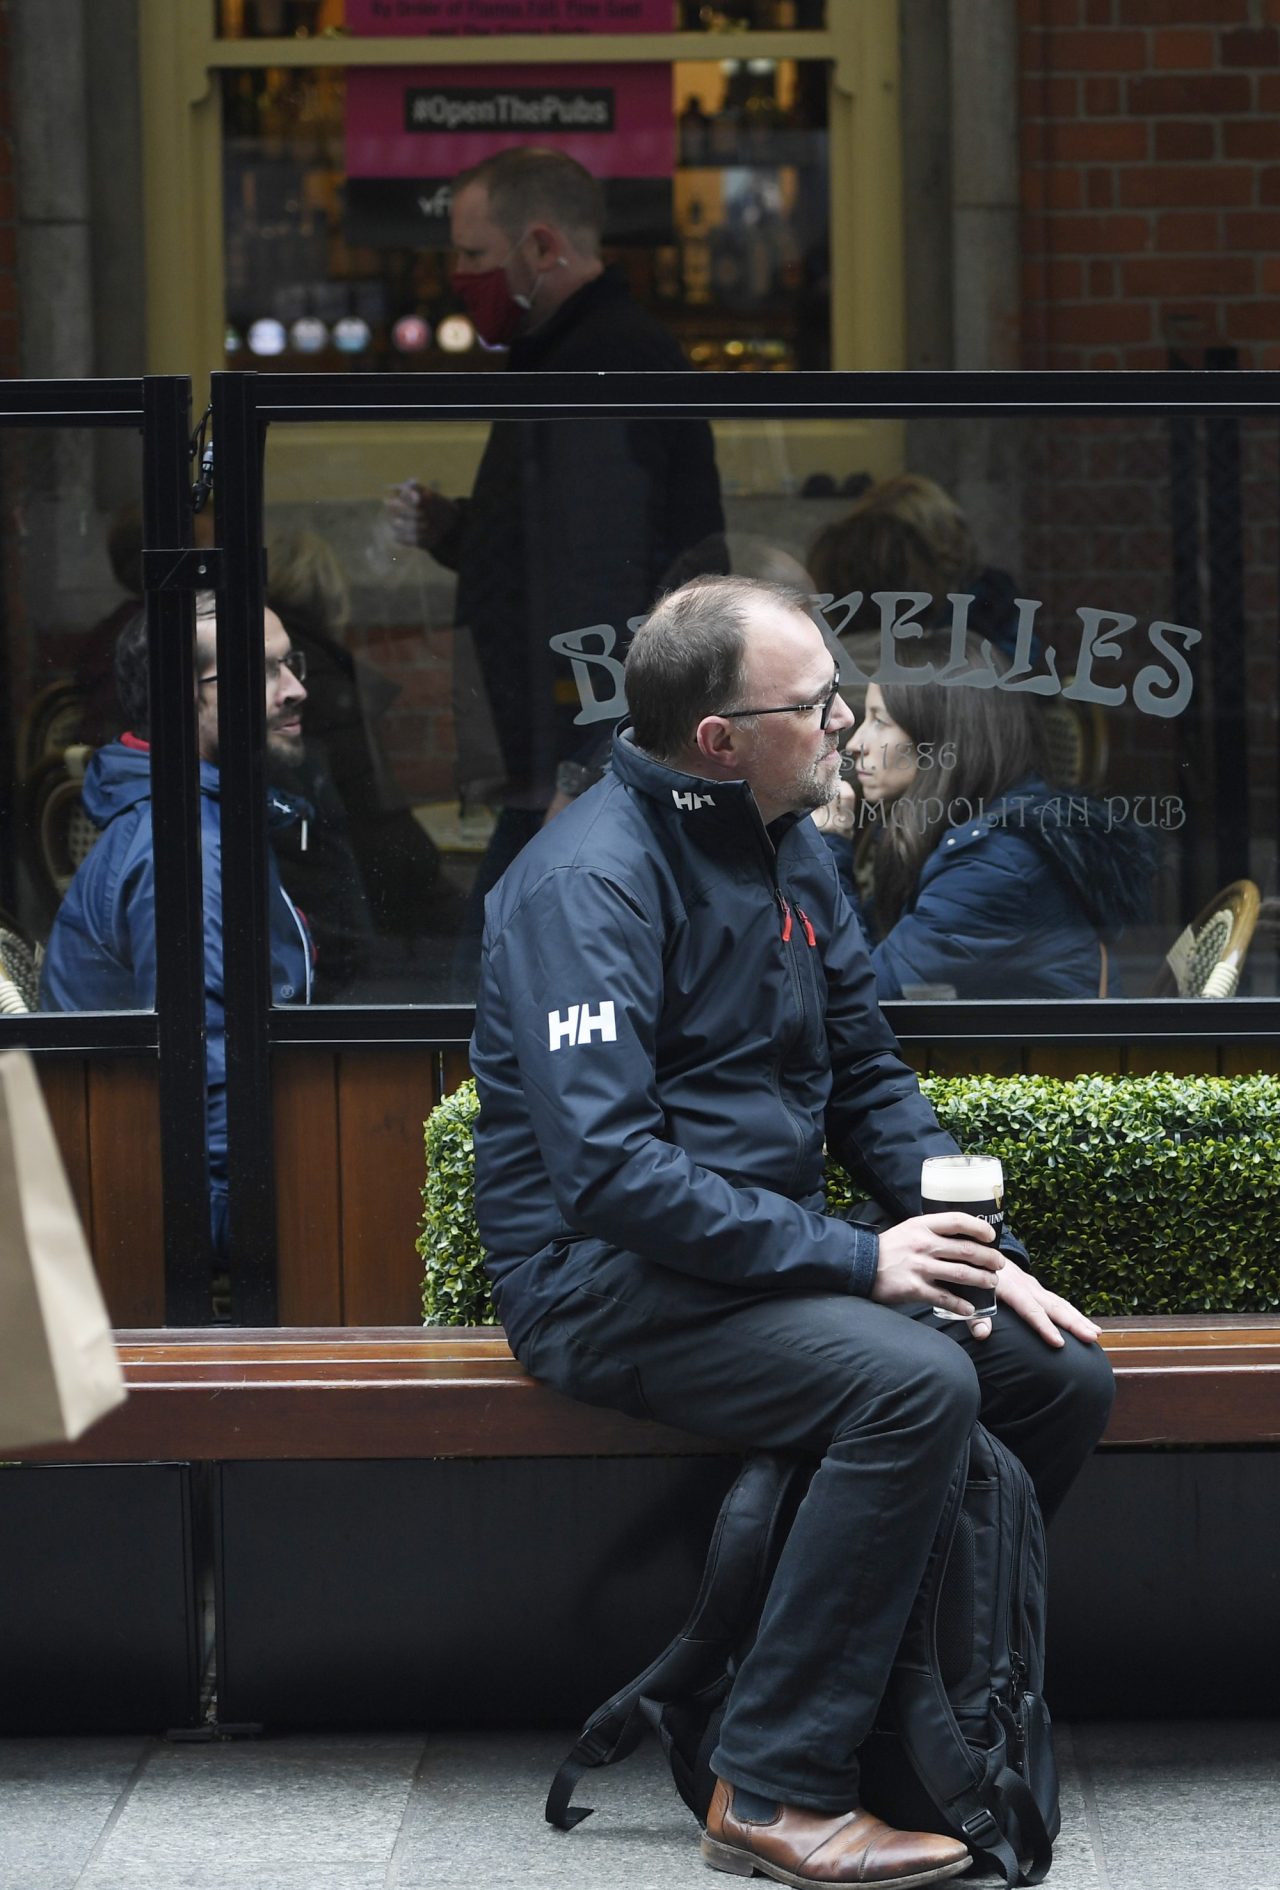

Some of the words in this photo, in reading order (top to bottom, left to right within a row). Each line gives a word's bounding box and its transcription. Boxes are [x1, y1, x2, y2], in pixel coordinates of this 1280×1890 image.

[412, 95, 608, 127] #OpenThePubs
[550, 590, 1202, 726] BXELLES
[1103, 795, 1186, 834] PUB
[548, 1001, 617, 1052] HH
